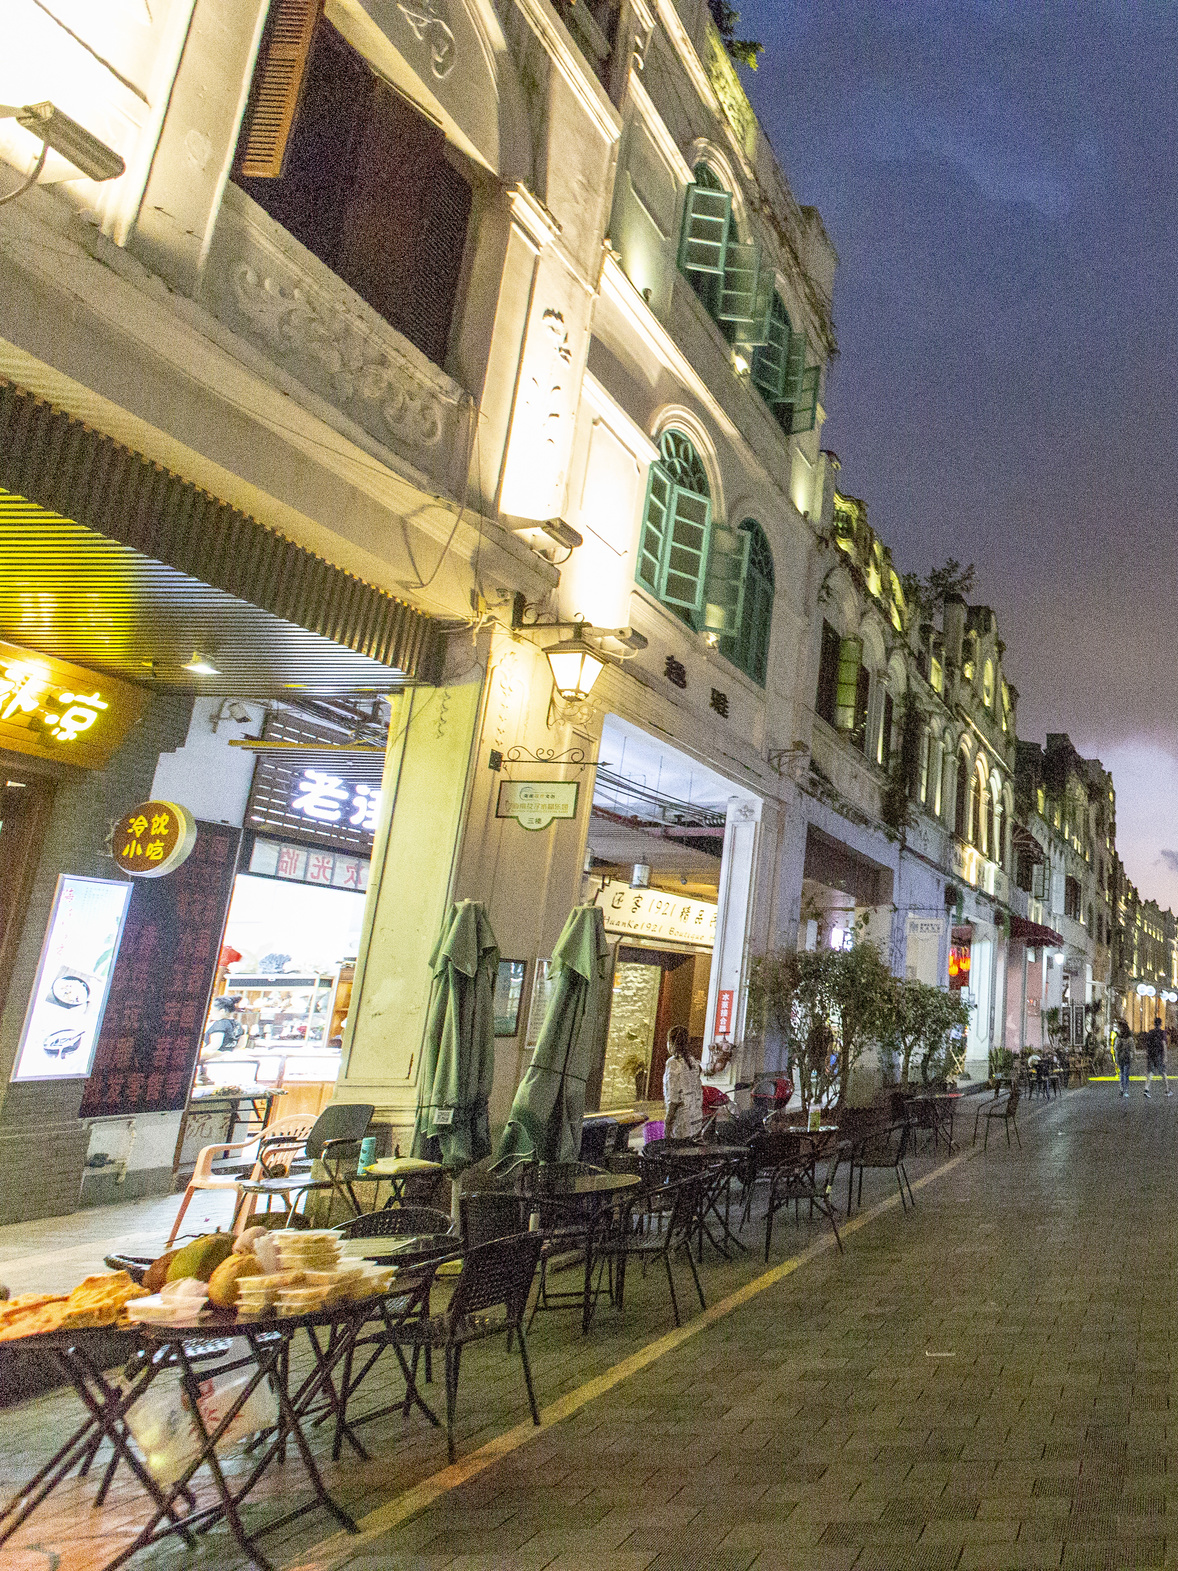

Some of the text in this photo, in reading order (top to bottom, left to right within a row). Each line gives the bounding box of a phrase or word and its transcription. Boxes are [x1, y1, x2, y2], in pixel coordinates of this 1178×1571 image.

[127, 813, 170, 838] 冷饮
[122, 839, 165, 860] 小吃
[668, 927, 705, 941] Boutique
